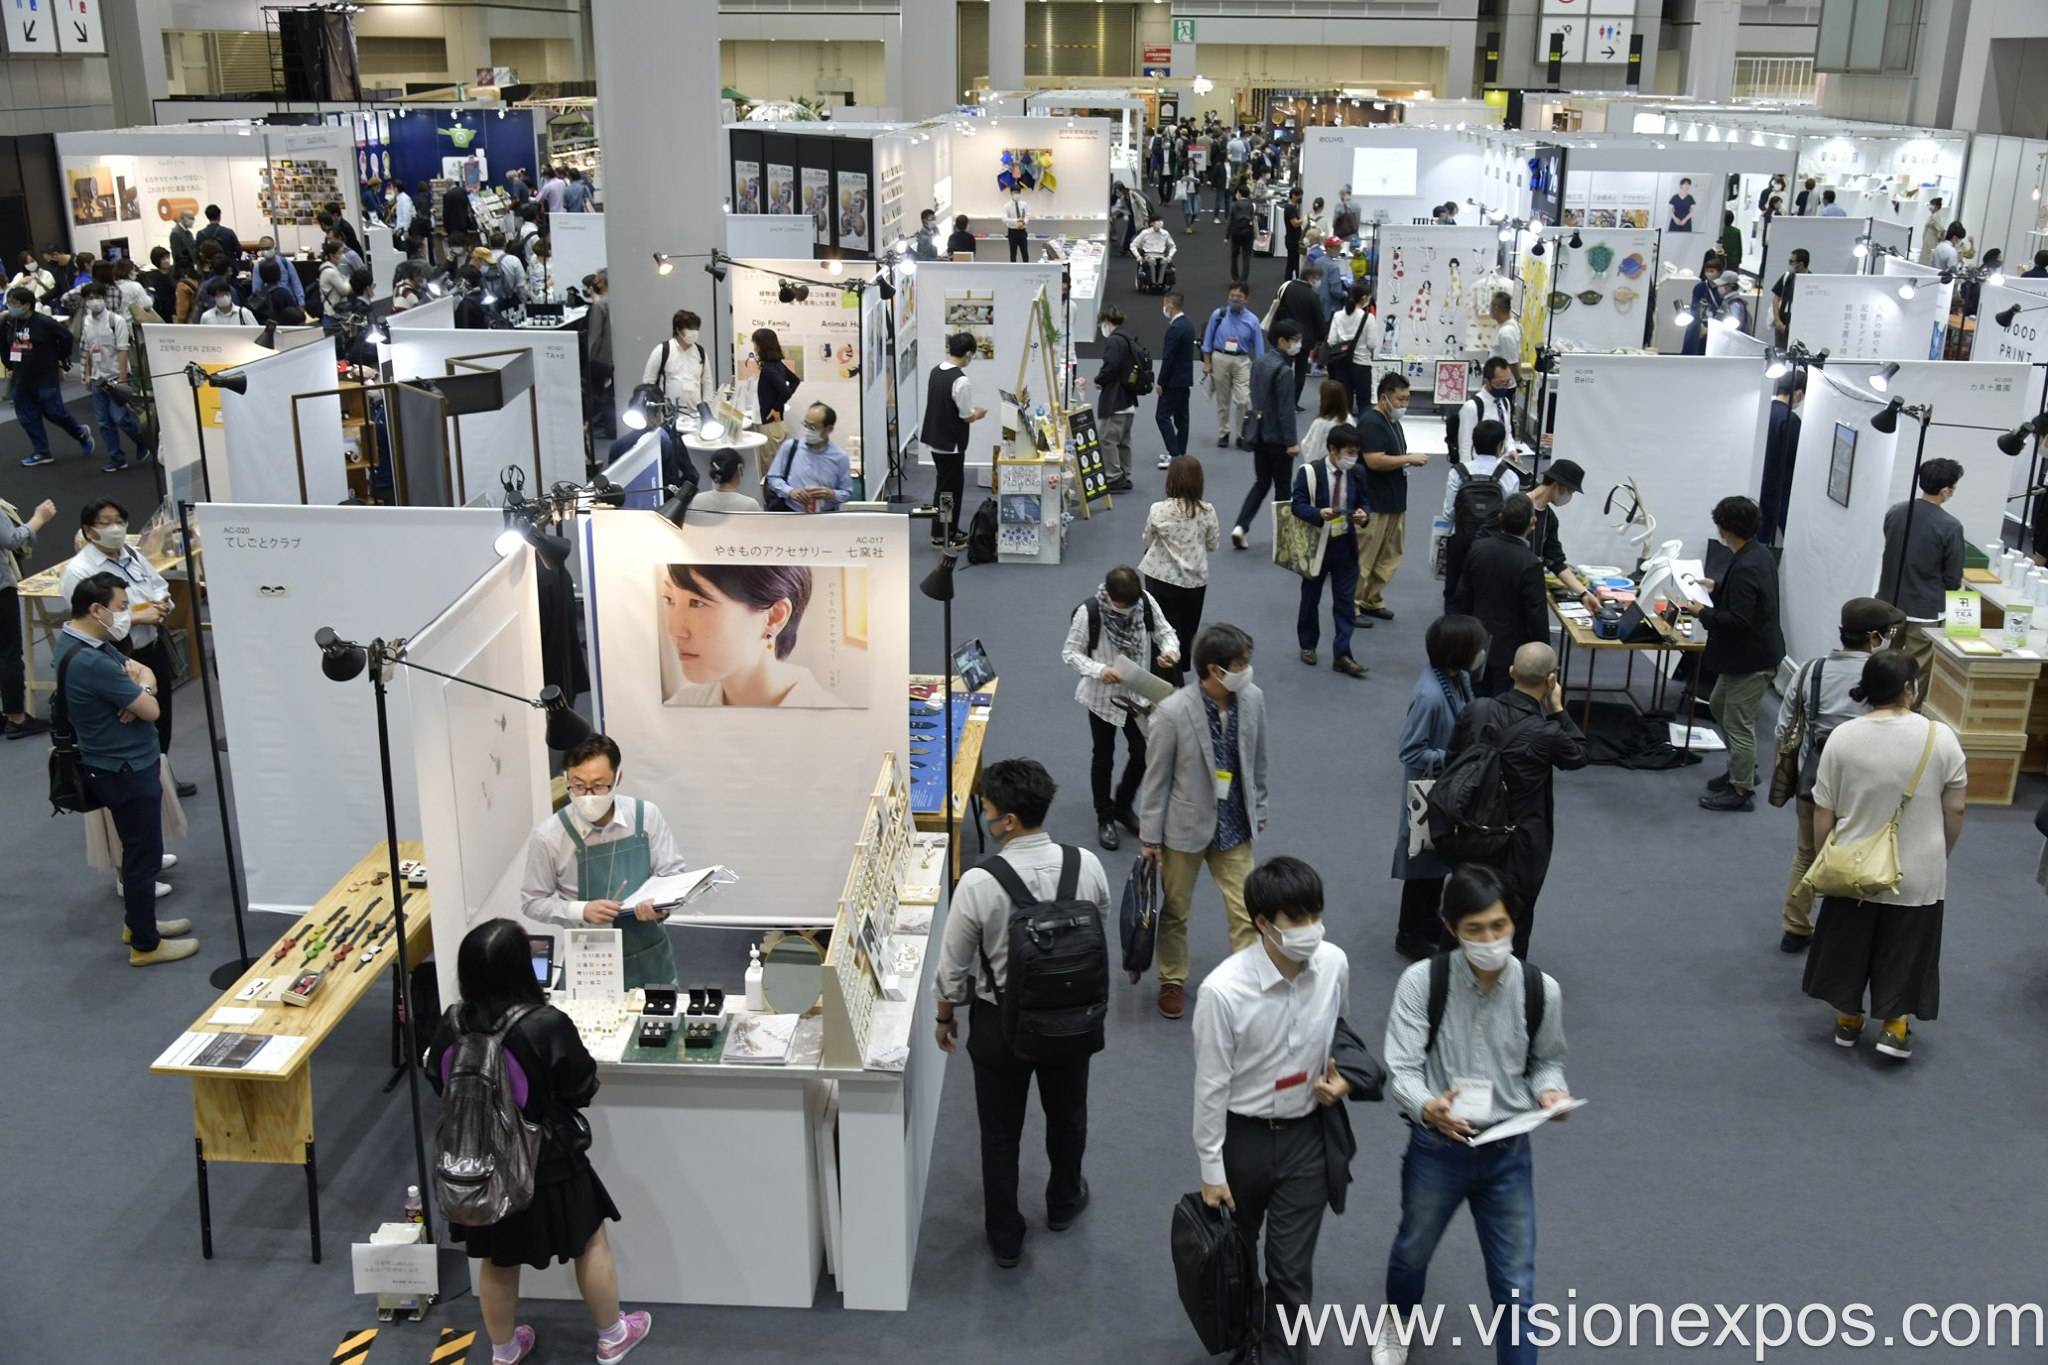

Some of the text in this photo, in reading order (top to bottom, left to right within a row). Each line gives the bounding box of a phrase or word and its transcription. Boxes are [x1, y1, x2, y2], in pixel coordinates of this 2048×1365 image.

[752, 319, 790, 328] Clip Family
[160, 344, 181, 352] ZERO
[201, 345, 223, 353] ZERO
[2000, 344, 2032, 362] PRINT
[224, 537, 302, 549] てしごとクラブ
[855, 536, 884, 544] AC-017
[714, 545, 833, 557] やきものアクセサリー
